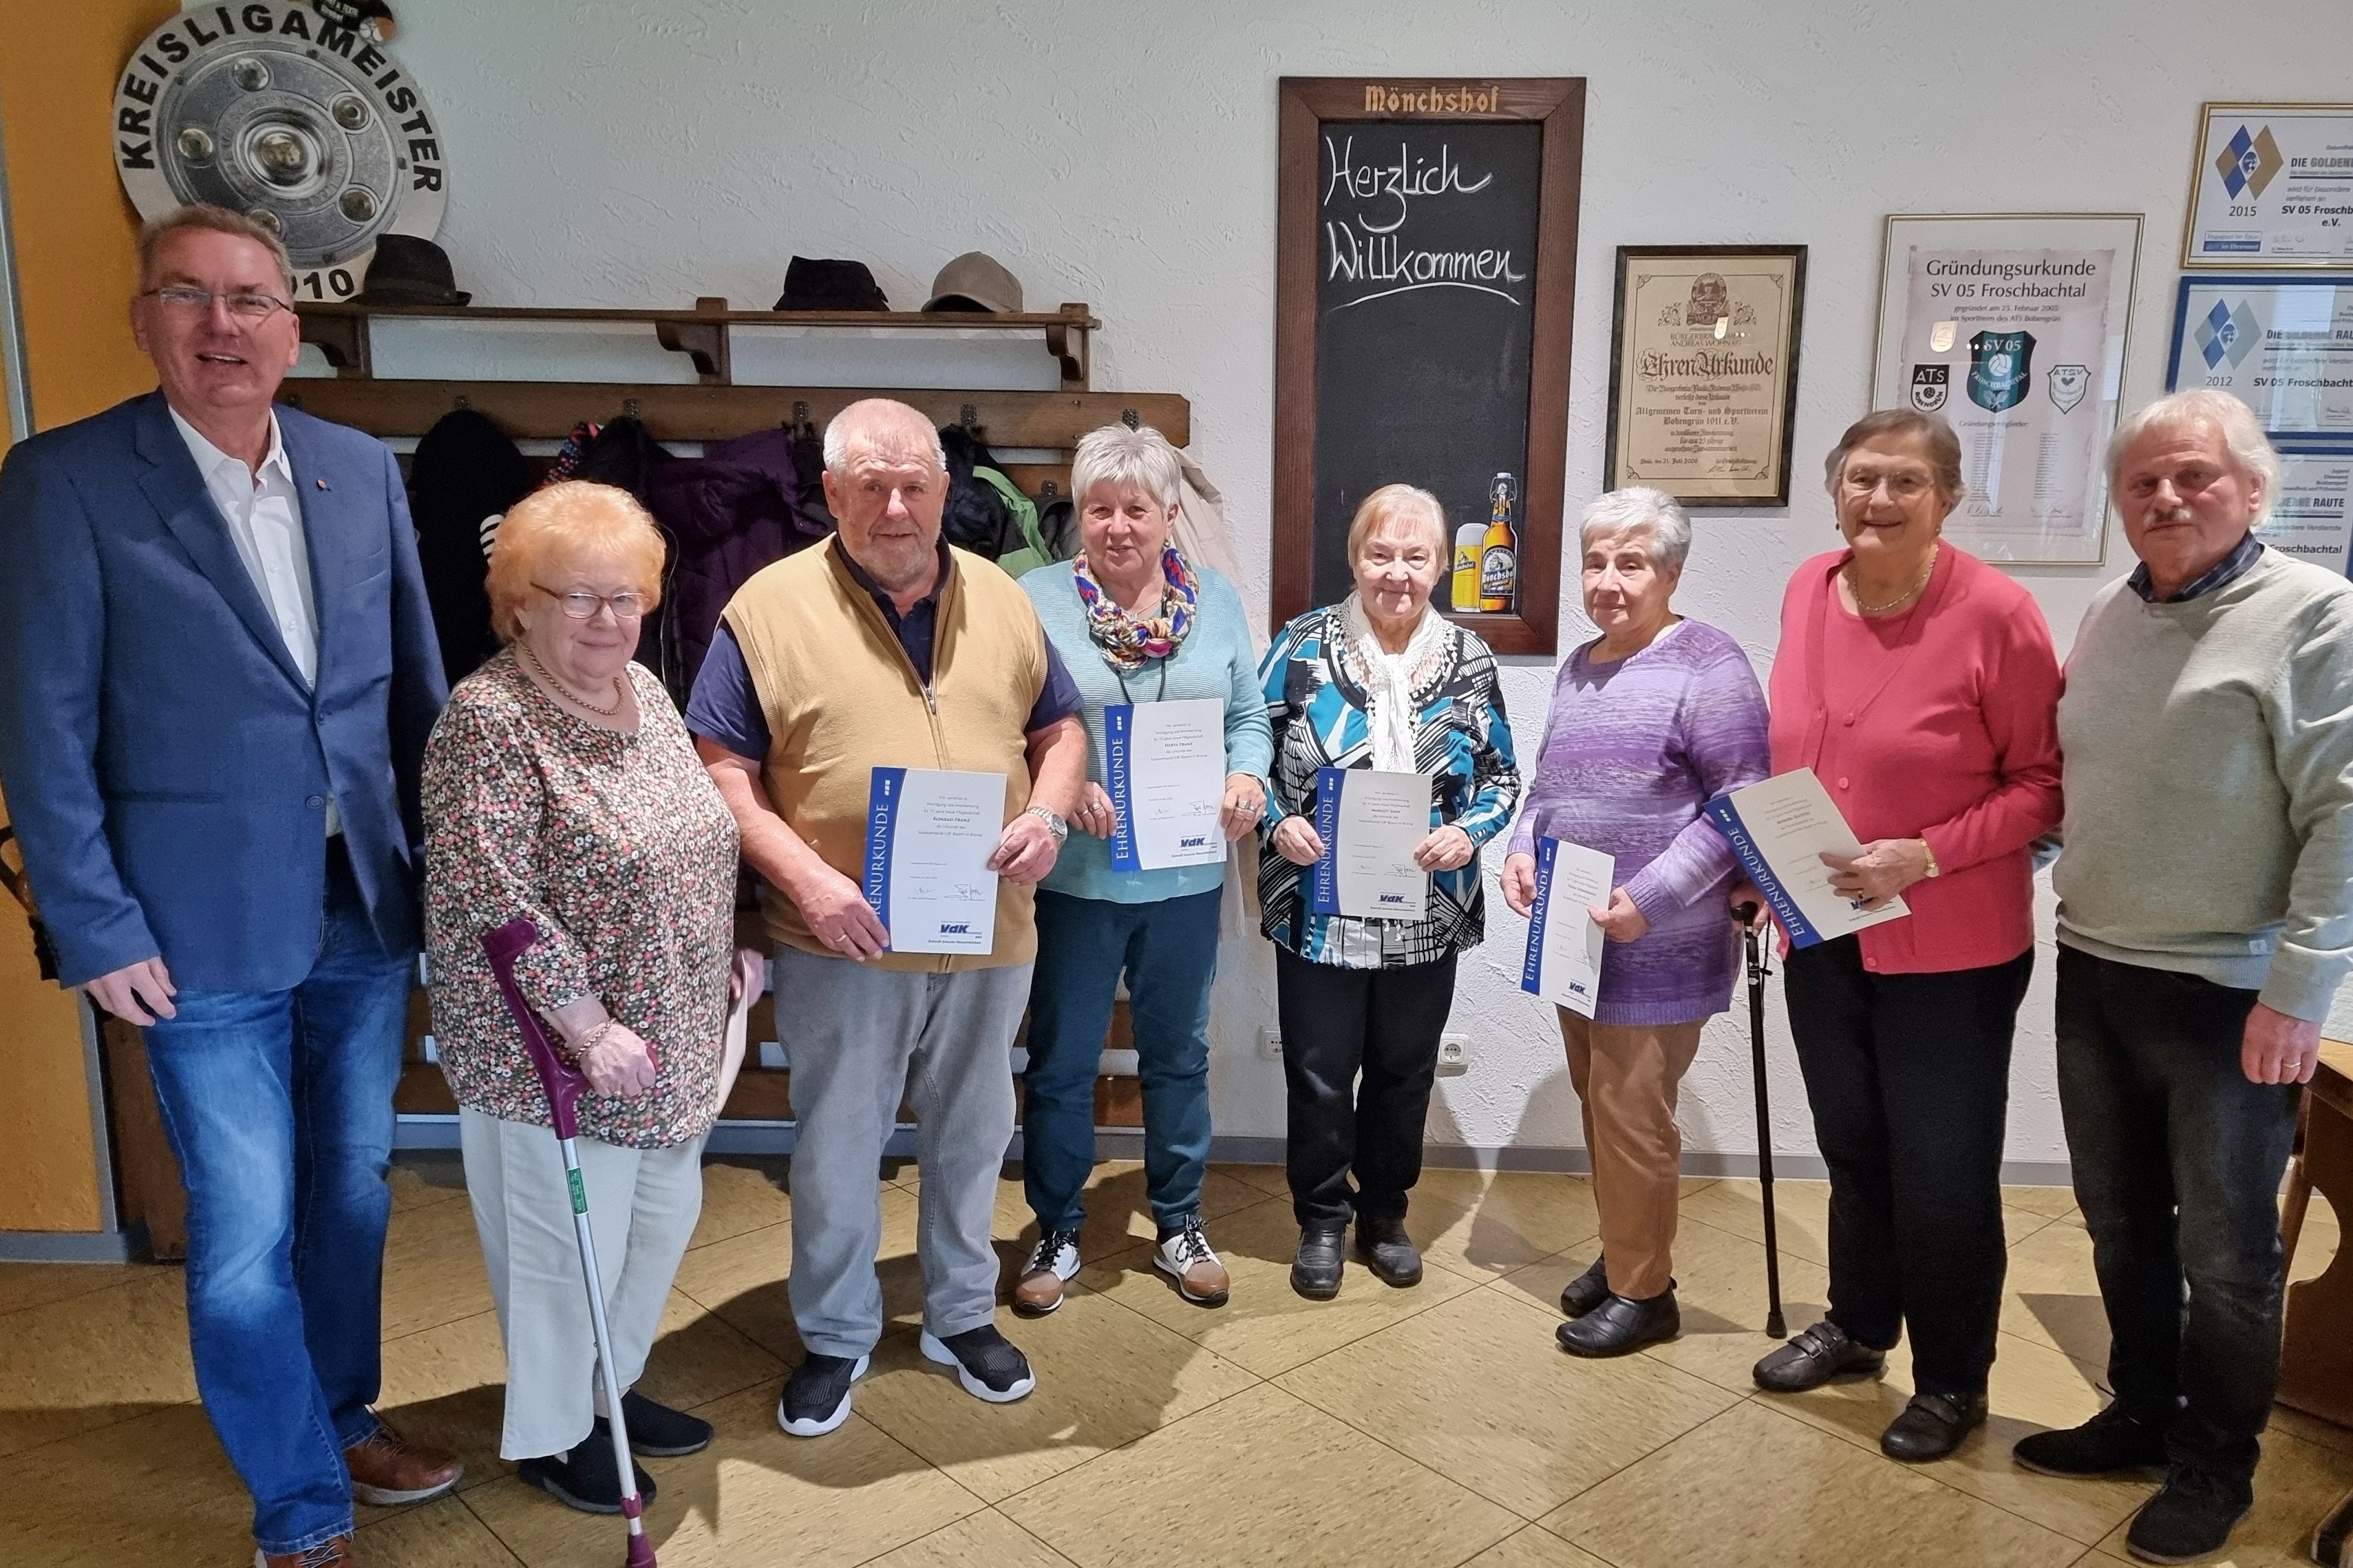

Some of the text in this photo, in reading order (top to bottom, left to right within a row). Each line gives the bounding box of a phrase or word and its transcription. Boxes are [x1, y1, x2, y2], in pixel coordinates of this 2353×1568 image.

[118, 3, 442, 193] KREISLIGAMEISTER
[1365, 85, 1500, 113] Mönchshof
[2290, 158, 2308, 167] DIE
[1324, 136, 1492, 233] Herzlich
[2228, 206, 2257, 217] 2015
[2281, 205, 2353, 214] SV 05 Froschb
[2321, 218, 2341, 226] e.V.
[1325, 220, 1526, 283] Willkommen
[1926, 258, 2096, 280] Gründungsurkunde
[293, 269, 354, 299] 10
[1930, 283, 2086, 298] SV 05 Froschbachtal
[1954, 305, 1988, 313] gegründet
[2266, 330, 2283, 339] DIE
[1984, 339, 2021, 352] SV 05
[1915, 369, 1945, 383] ATS
[2205, 376, 2233, 387] 2012
[2253, 378, 2268, 387] SV
[2270, 378, 2284, 387] 05
[1915, 391, 1944, 407] BOBENGRÜN
[1635, 407, 1681, 416] Allgemeinen
[2313, 498, 2345, 507] RAUTE
[1112, 738, 1129, 859] EHRENURKUNDE
[1180, 837, 1206, 848] VdK
[1318, 797, 1334, 903] EHRENURKUNDE
[1727, 827, 1805, 936] EHRENURKUNDE
[1379, 894, 1405, 903] VdK
[940, 924, 970, 934] VdK
[1525, 867, 1549, 981] EHRENURKUNDE
[1568, 982, 1586, 994] VdK
